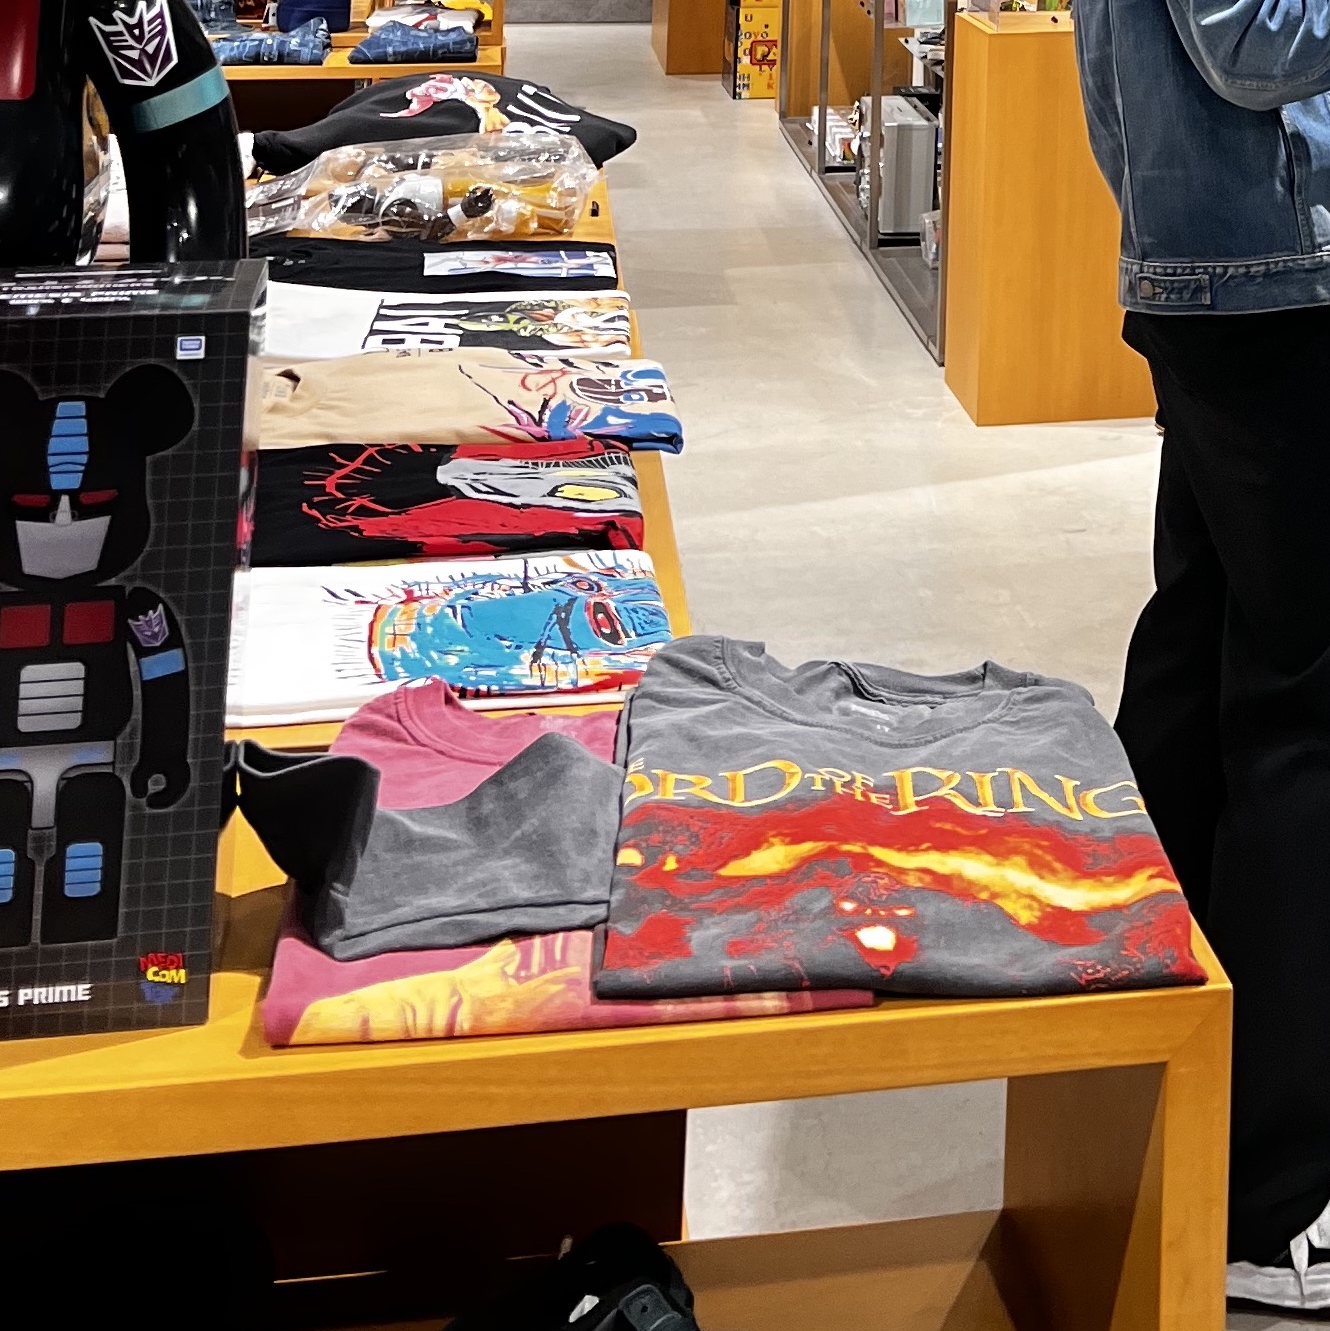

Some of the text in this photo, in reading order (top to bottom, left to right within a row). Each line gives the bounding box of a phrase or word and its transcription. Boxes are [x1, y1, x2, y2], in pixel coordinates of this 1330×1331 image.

[624, 758, 802, 808] ORD
[881, 766, 1147, 821] RING
[17, 983, 94, 1006] PRIME
